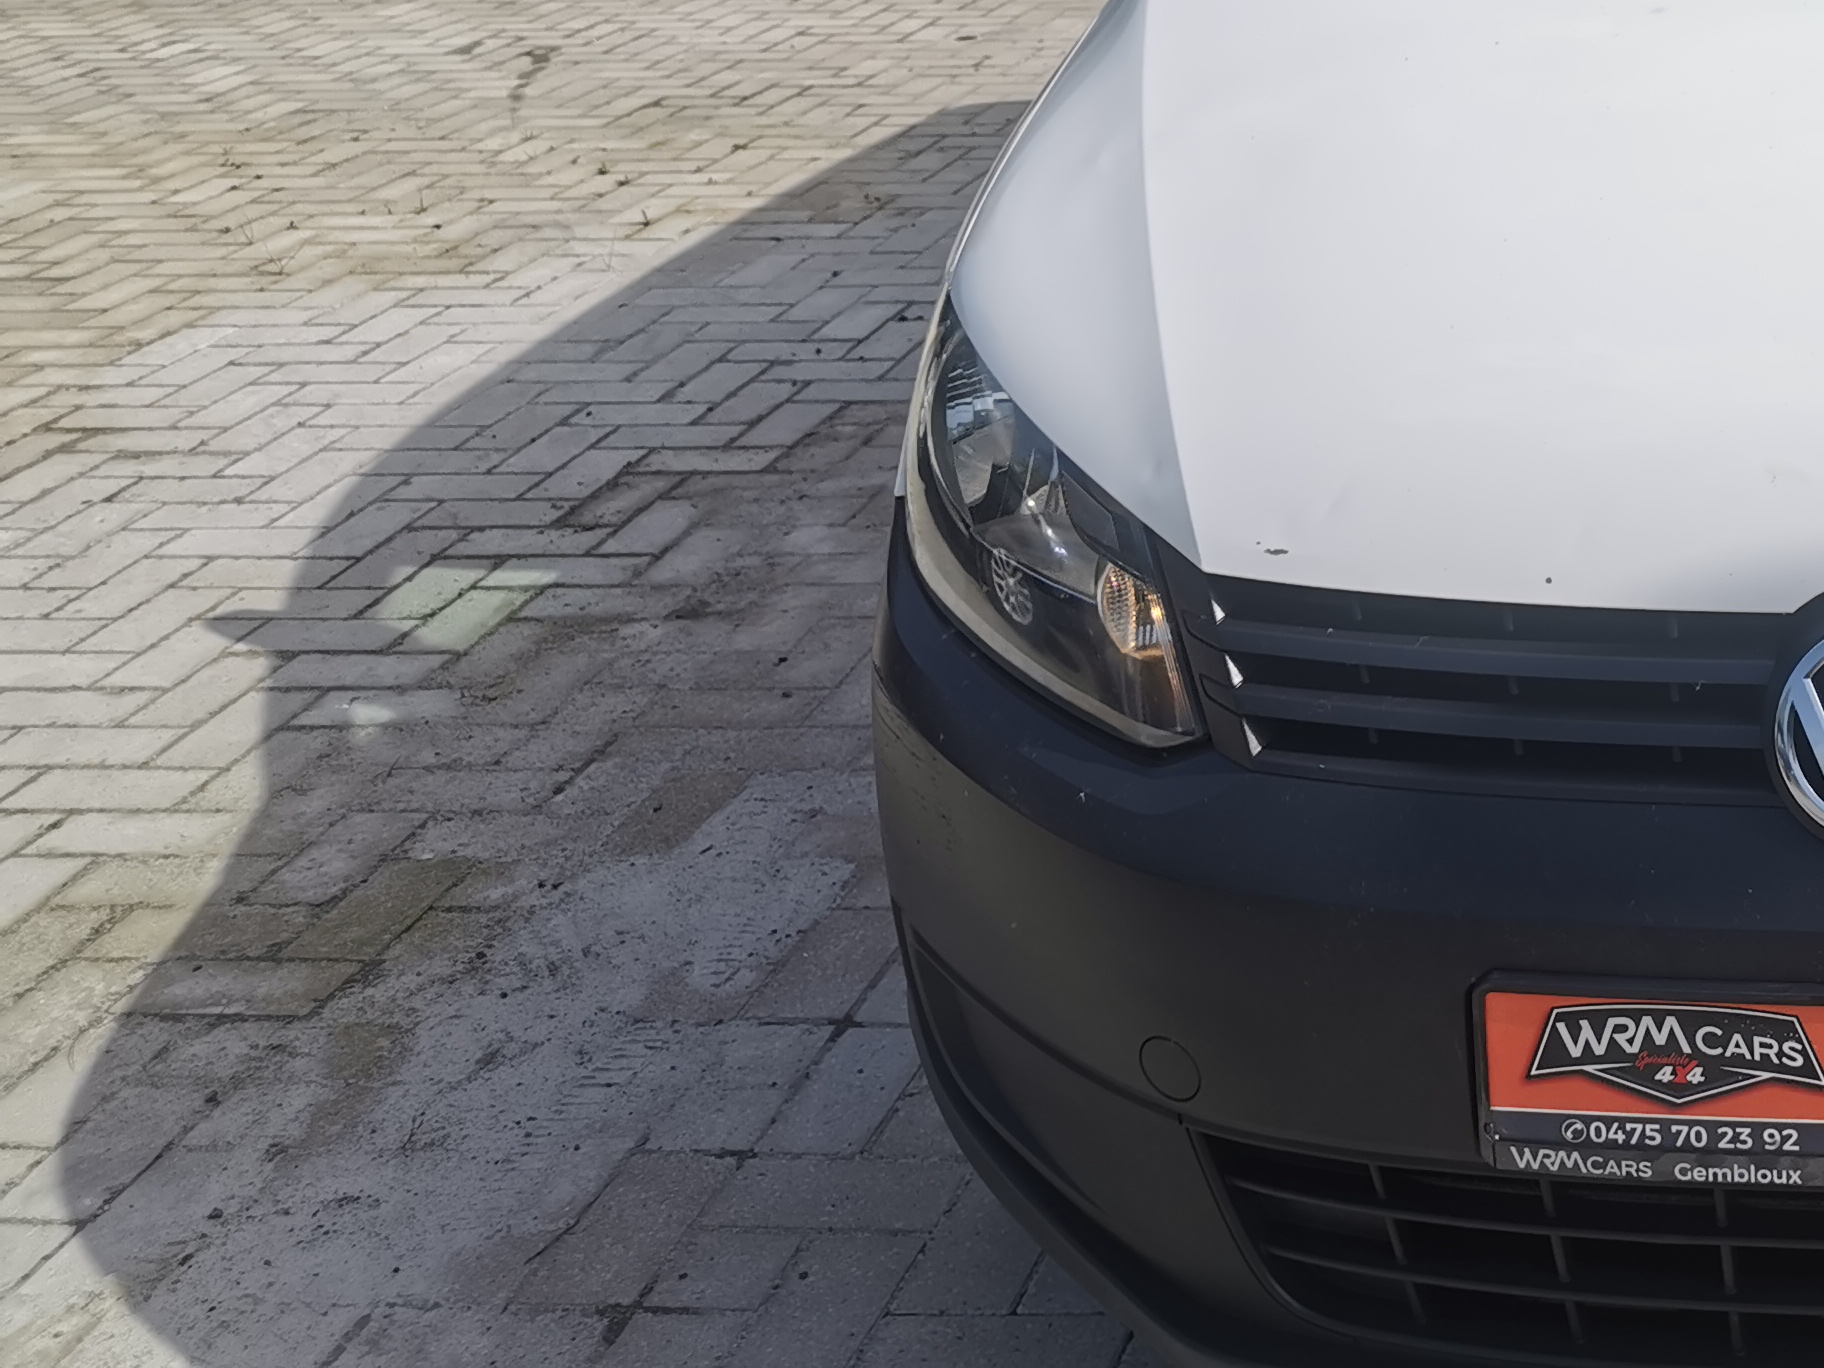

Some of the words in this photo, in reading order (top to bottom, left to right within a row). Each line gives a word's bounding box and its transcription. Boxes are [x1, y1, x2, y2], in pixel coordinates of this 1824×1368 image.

[1589, 1122, 1661, 1146] 0475
[1670, 1125, 1708, 1148] 70
[1717, 1127, 1753, 1149] 23
[1763, 1129, 1800, 1151] 92
[1674, 1162, 1803, 1185] Gembloux
